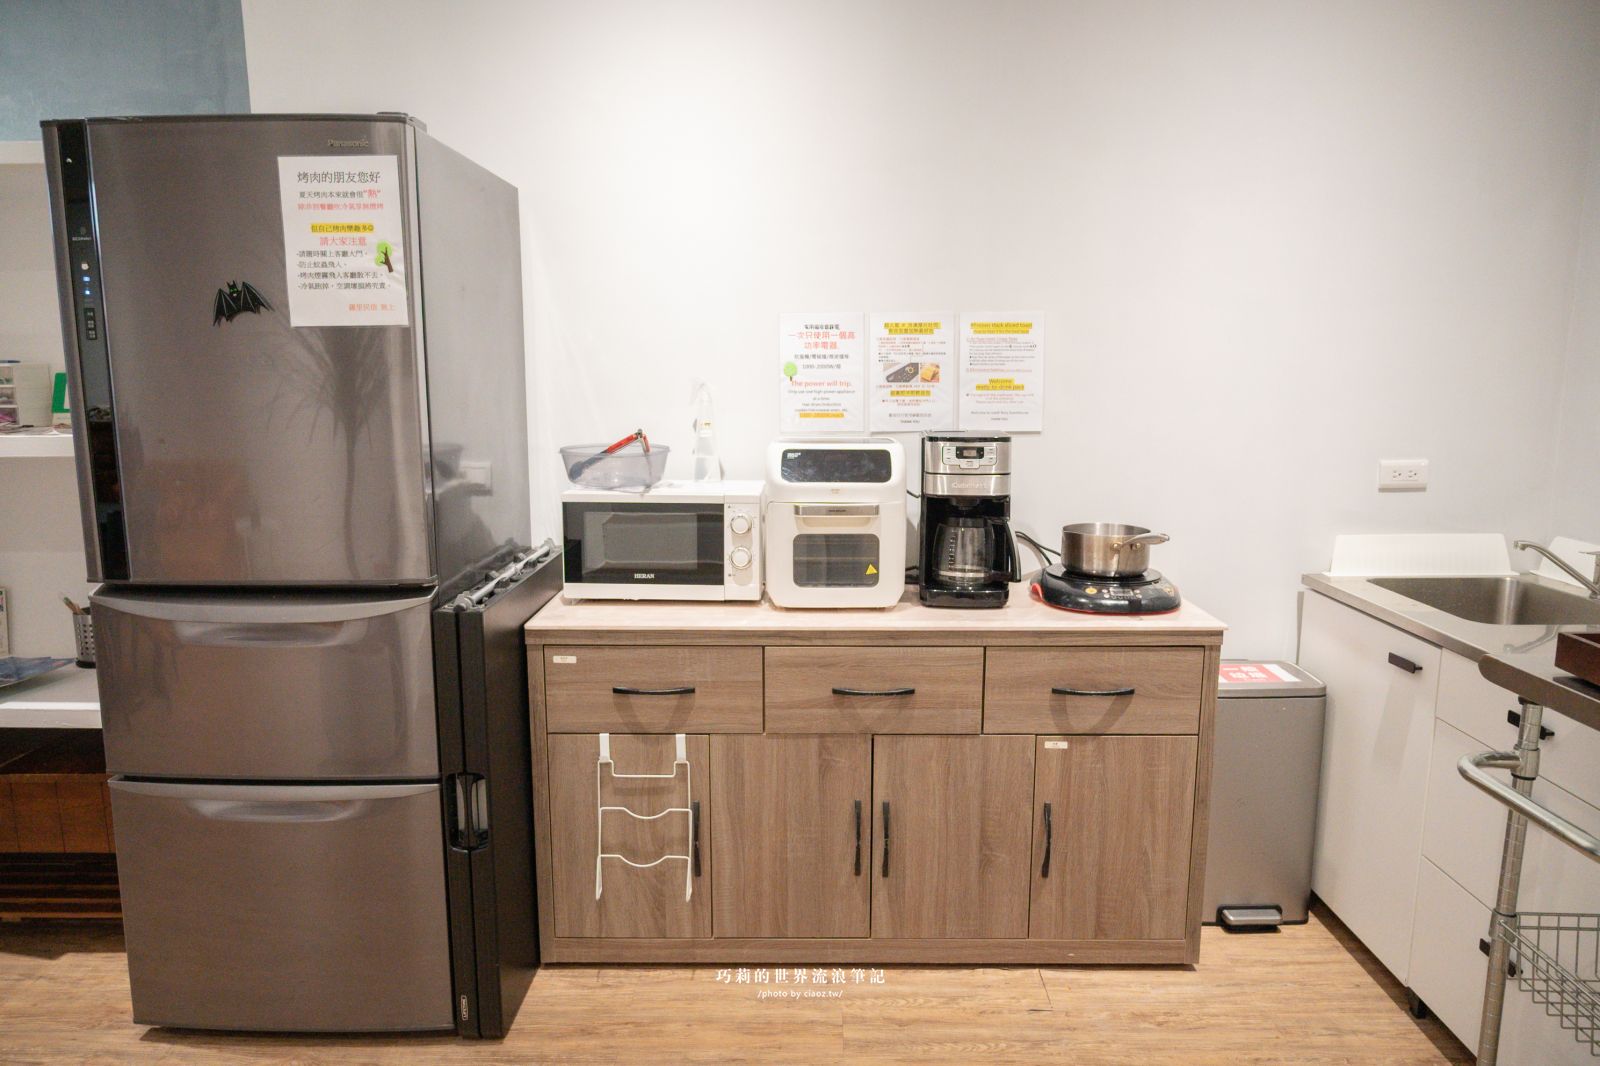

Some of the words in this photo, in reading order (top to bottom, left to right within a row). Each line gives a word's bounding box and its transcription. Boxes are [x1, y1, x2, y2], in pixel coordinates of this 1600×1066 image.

[297, 170, 381, 184] 烤肉的朋友您好
[319, 236, 367, 247] 請大家注意
[791, 379, 803, 387] The
[827, 379, 837, 387] will
